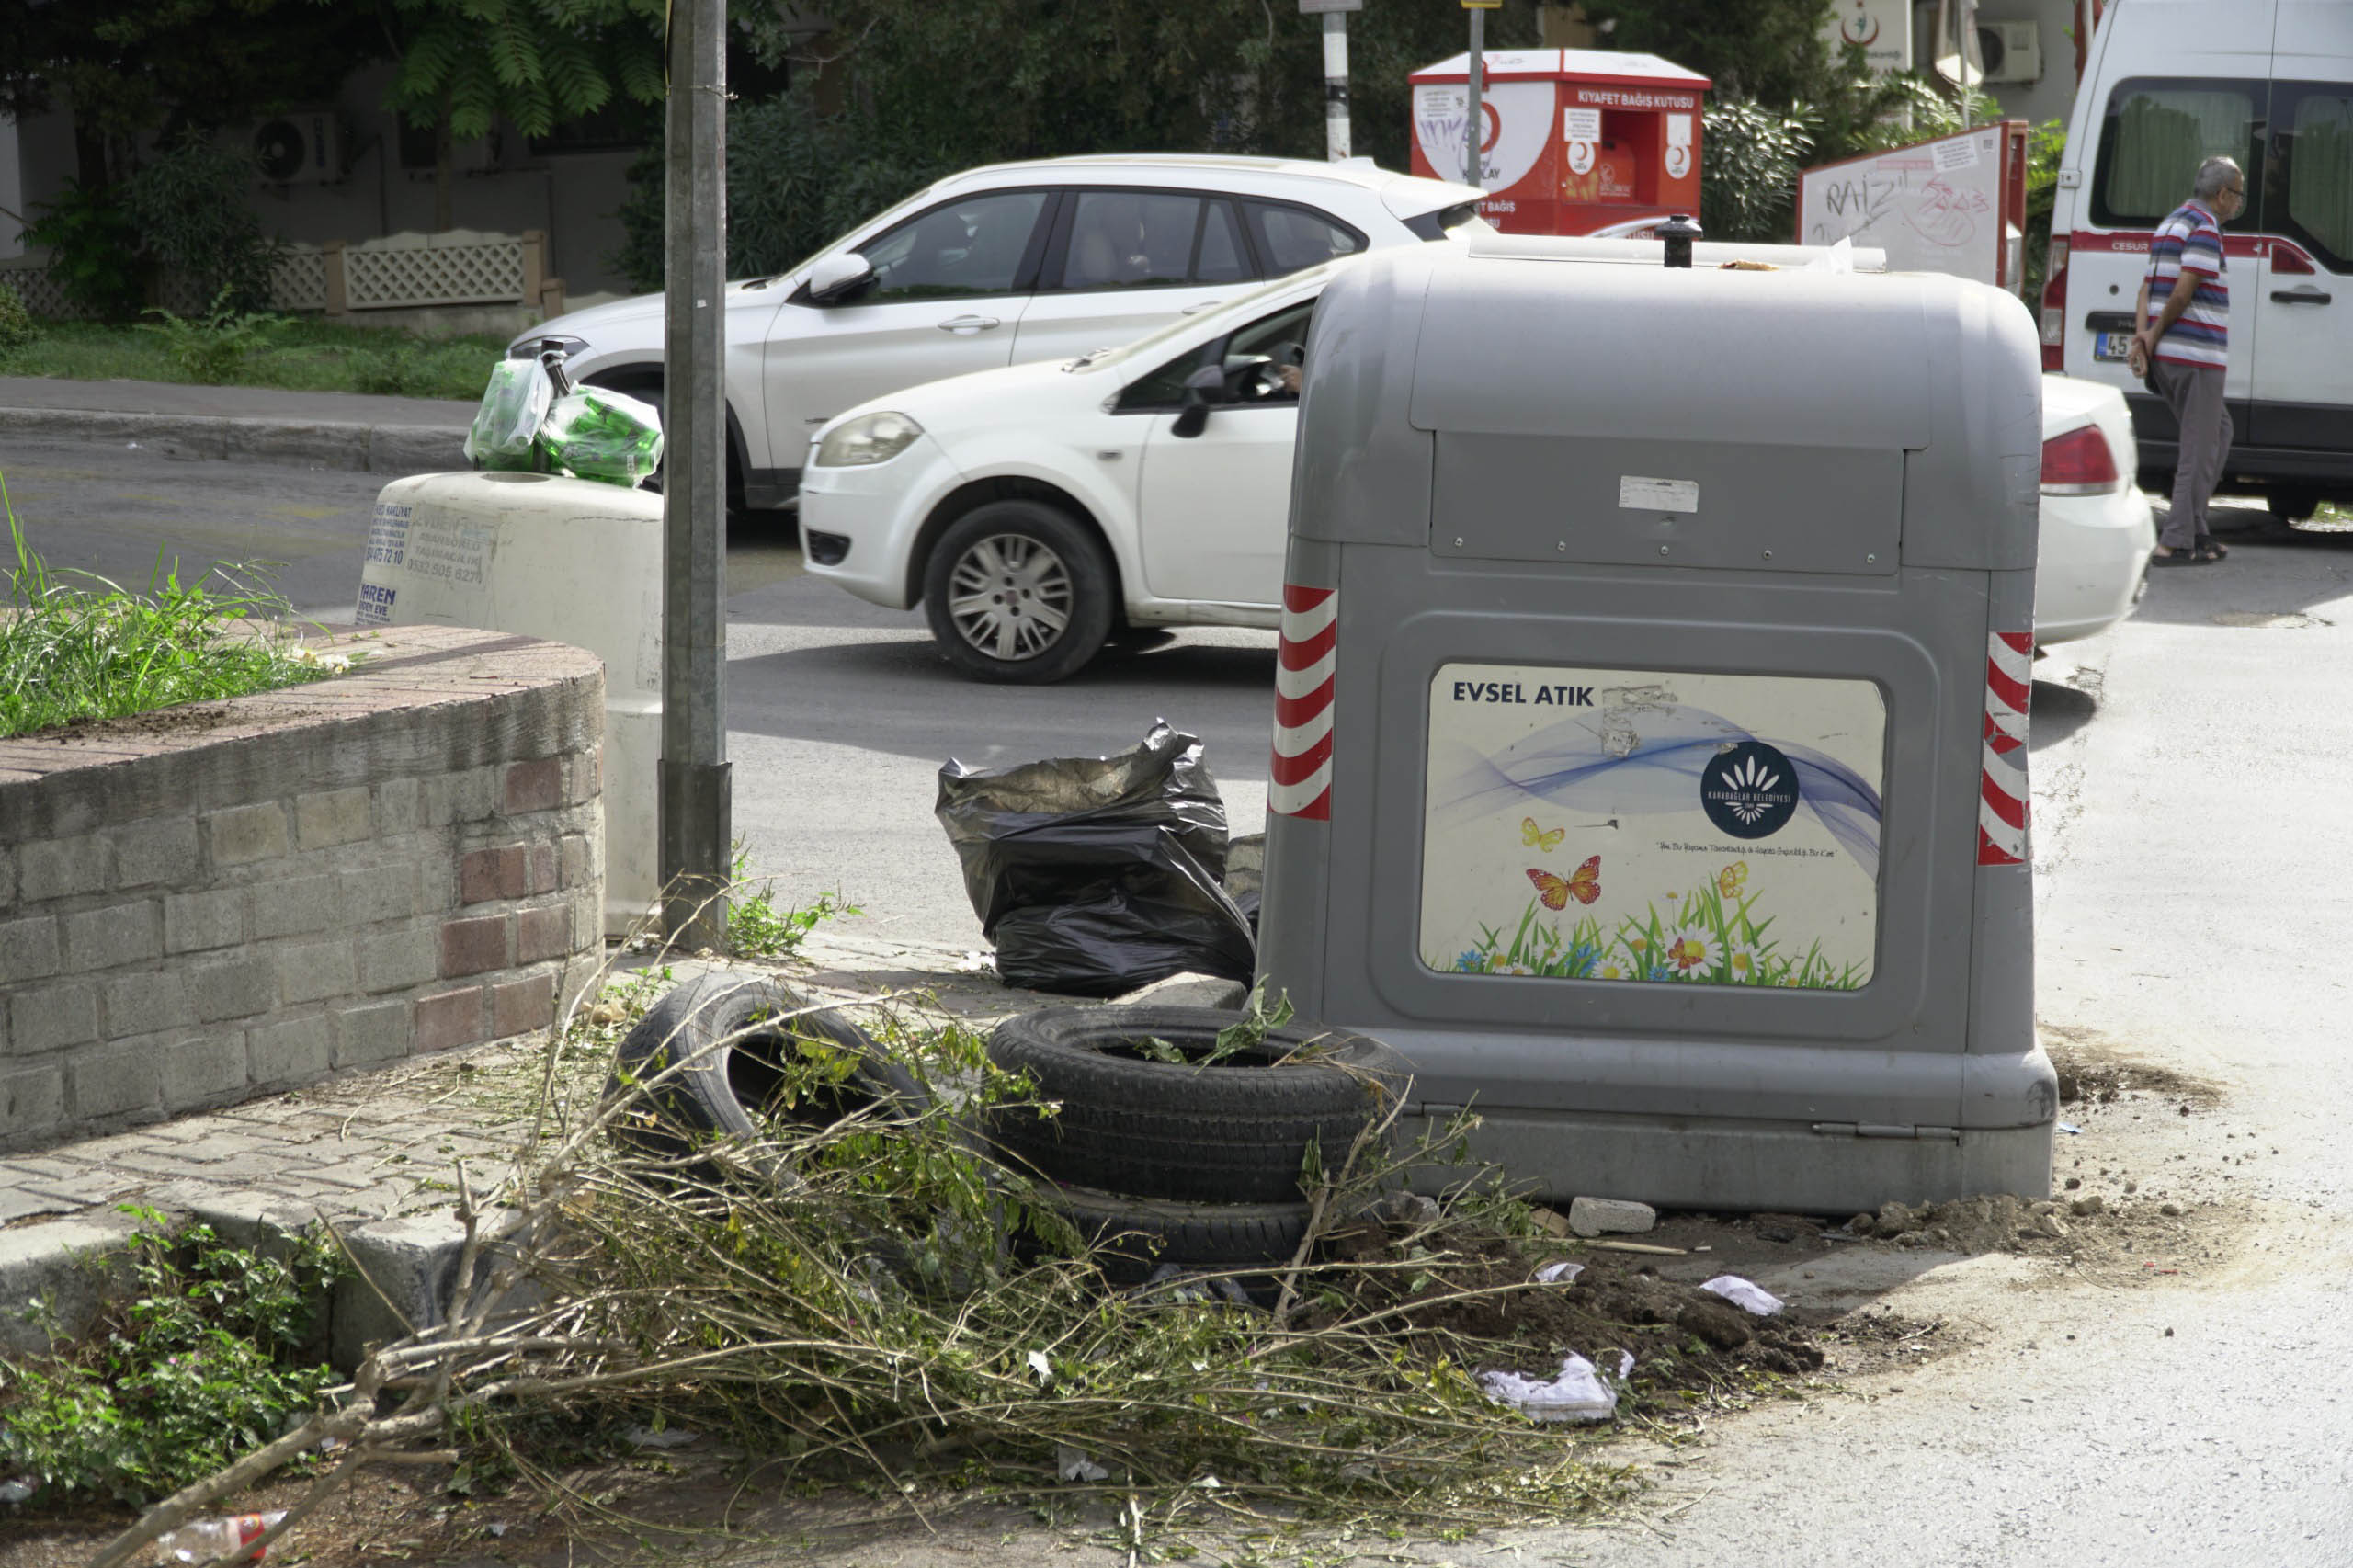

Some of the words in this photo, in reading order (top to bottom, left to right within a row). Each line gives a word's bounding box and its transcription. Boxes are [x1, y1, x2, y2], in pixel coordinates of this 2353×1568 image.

[1578, 90, 1620, 105] KIYAFET
[1620, 92, 1652, 108] BAĞIŞ
[1654, 97, 1694, 108] KUTUSU
[2111, 242, 2149, 251] CESUR
[2108, 335, 2128, 356] 45
[393, 549, 404, 565] 10
[1454, 682, 1527, 704] EVSEL
[1534, 685, 1595, 707] ATIK
[1753, 792, 1791, 803] BELEDİYESİ
